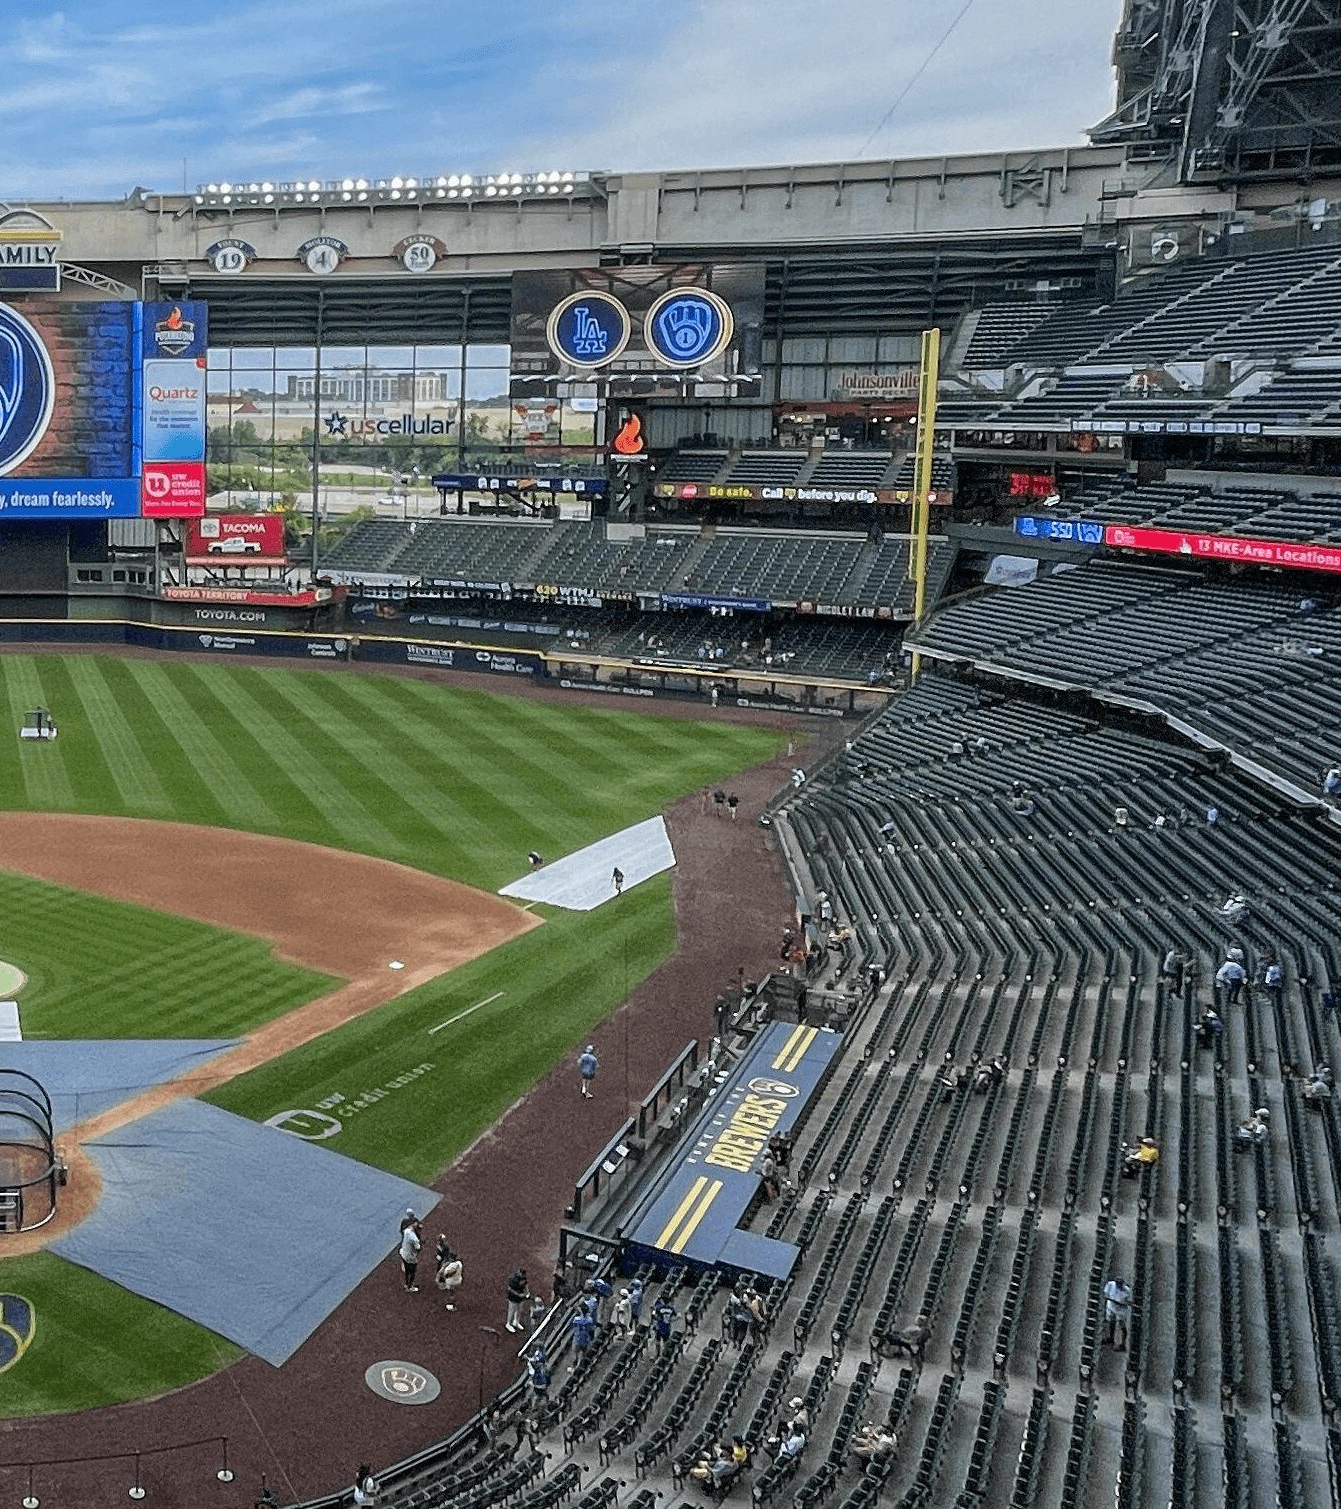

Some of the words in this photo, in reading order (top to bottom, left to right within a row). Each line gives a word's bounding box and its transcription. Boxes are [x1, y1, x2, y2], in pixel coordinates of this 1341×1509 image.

[220, 253, 242, 269] 19
[314, 251, 327, 267] 4
[409, 246, 430, 260] 50
[838, 371, 920, 389] Johnsonville
[149, 386, 198, 402] Quartz
[350, 414, 455, 435] uscellular
[10, 490, 50, 507] dream
[52, 490, 115, 510] fearlessly.
[709, 486, 724, 497] Be
[726, 487, 753, 498] safe.
[761, 487, 784, 499] Call
[797, 489, 833, 501] before
[834, 491, 855, 503] you
[856, 490, 877, 503] dig.
[221, 524, 266, 533] TACOMA
[1198, 539, 1210, 552] 13
[1213, 541, 1273, 559] MKE-Area
[1276, 547, 1341, 566] Locations
[166, 589, 200, 598] TOYOTA
[202, 590, 248, 600] TERRITORY
[536, 584, 559, 596] 620
[195, 609, 266, 622] TOYOTA.COM
[385, 1062, 437, 1089] union
[704, 1093, 788, 1174] BREWERS
